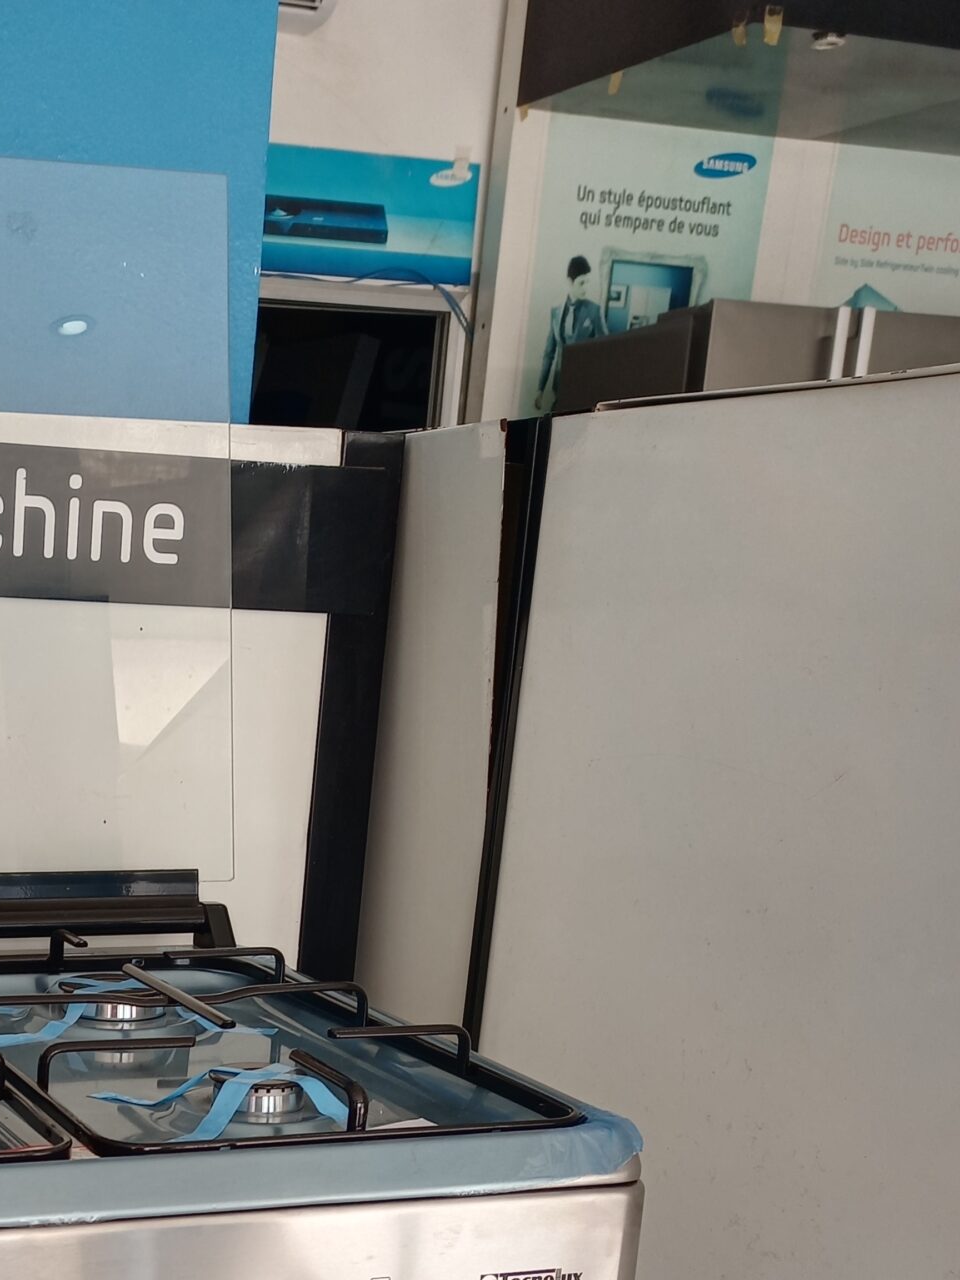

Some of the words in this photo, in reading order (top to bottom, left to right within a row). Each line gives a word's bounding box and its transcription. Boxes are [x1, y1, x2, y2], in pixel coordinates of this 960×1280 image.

[576, 184, 595, 203] Un
[599, 187, 634, 216] style
[637, 189, 732, 217] époustouflant
[579, 208, 602, 230] qui
[668, 216, 685, 234] de
[688, 222, 720, 238] vous
[838, 223, 891, 252] Design
[896, 230, 913, 249] et
[915, 232, 960, 256] perfo
